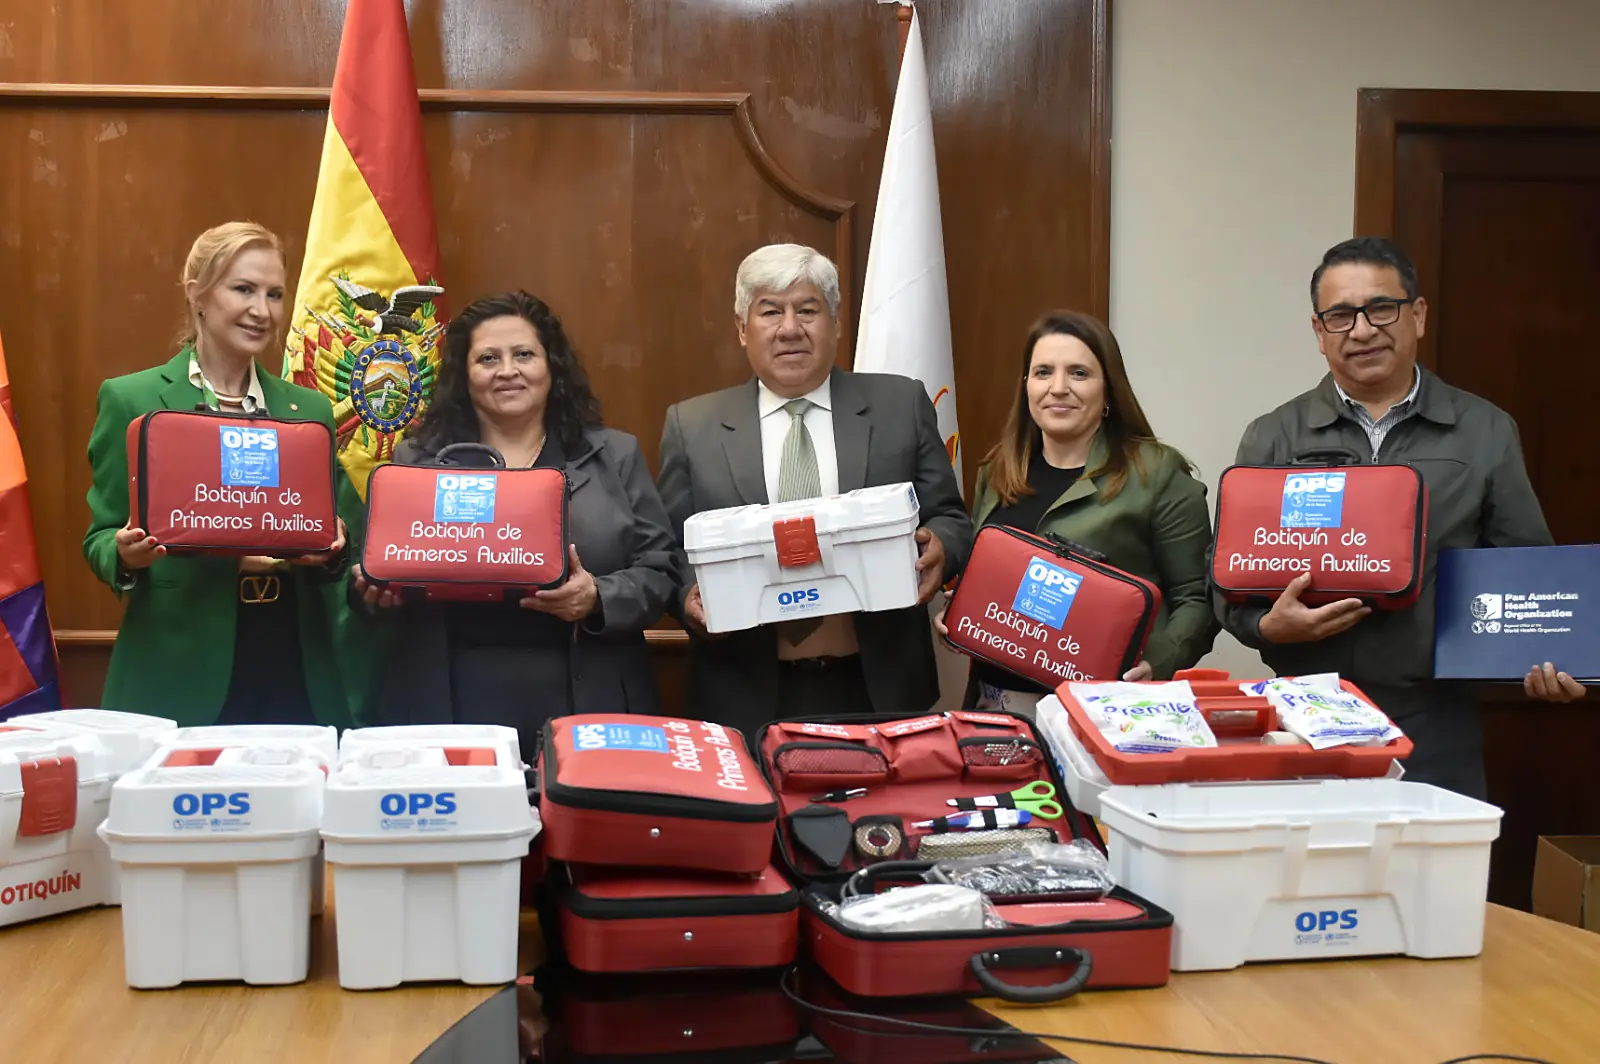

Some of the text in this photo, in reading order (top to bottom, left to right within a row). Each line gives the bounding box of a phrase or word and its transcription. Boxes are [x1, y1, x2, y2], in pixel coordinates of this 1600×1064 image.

[354, 341, 419, 384] BOLIVIA
[223, 431, 277, 450] OPS
[439, 477, 495, 490] OPS
[1288, 478, 1345, 493] OPS
[195, 484, 301, 508] Botiquín de
[170, 509, 323, 531] Primeros Auxilios
[411, 521, 522, 542] Botiquín de
[1254, 527, 1367, 550] Botiquín de
[384, 543, 544, 565] Primeros Auxilios
[1229, 553, 1391, 573] Primeros Auxilios
[1029, 564, 1079, 595] OPS
[778, 588, 820, 605] OPS
[1504, 592, 1578, 601] Pan American
[1504, 602, 1539, 610] Health
[1504, 610, 1573, 620] Organization
[957, 616, 1027, 659] Primeros
[985, 602, 1048, 642] Botiquín
[1057, 635, 1081, 655] de
[1104, 701, 1199, 717] Premie
[1280, 693, 1361, 708] Preer
[577, 724, 607, 748] OPS
[173, 792, 250, 816] OPS
[381, 792, 456, 816] OPS
[1, 869, 80, 905] OTIQUÍN
[1295, 909, 1358, 932] OPS
